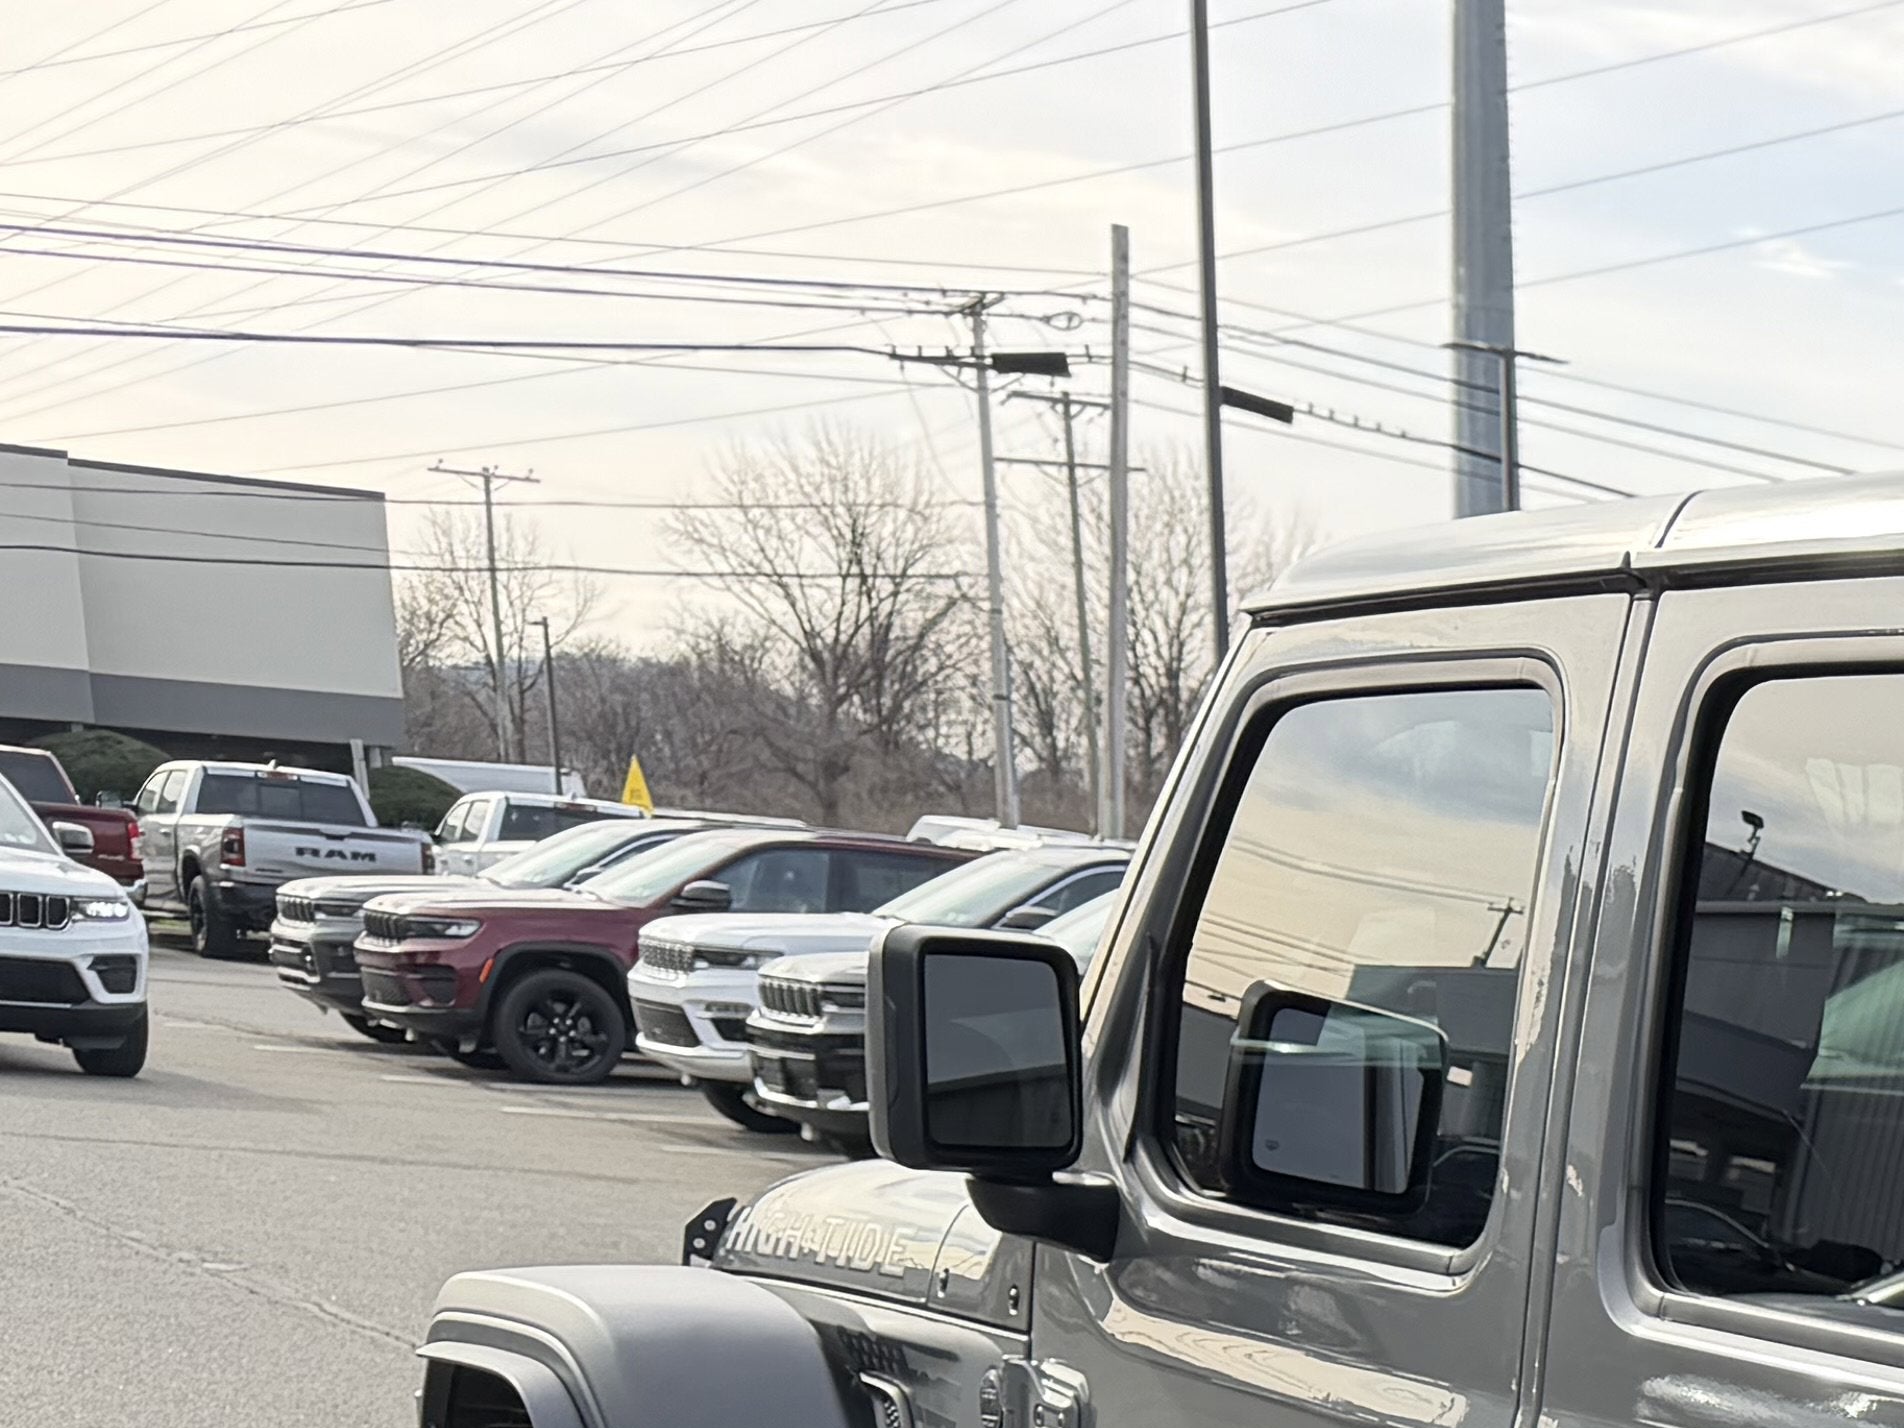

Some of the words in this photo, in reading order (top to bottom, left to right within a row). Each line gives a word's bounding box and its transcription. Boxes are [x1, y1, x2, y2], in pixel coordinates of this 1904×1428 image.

[295, 847, 377, 862] RAM
[726, 1205, 806, 1260] HIGH
[813, 1214, 916, 1278] TIDE
